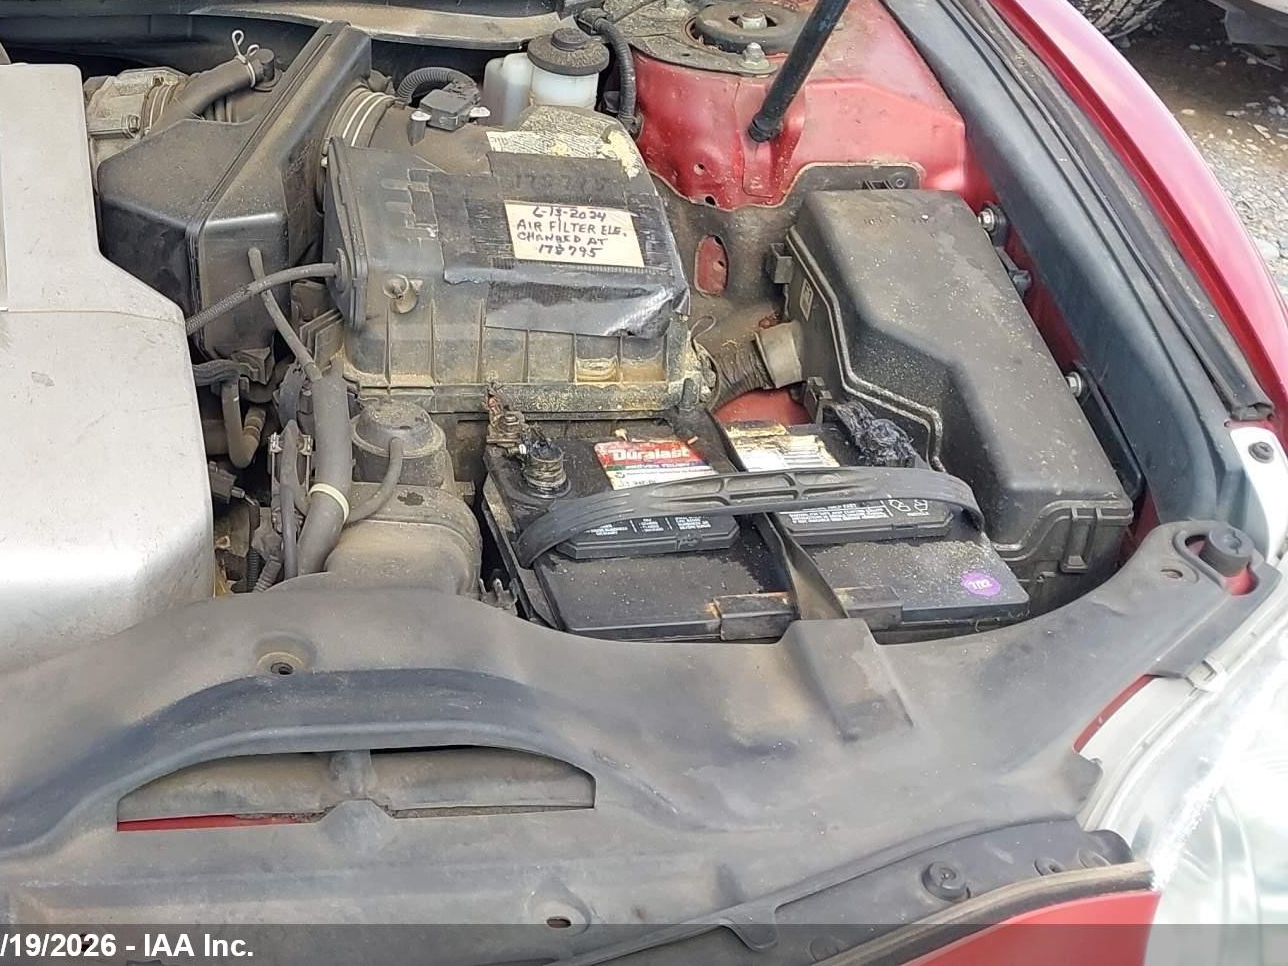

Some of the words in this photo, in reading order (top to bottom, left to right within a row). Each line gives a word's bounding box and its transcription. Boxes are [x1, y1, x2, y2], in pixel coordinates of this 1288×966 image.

[516, 219, 543, 232] AIR
[549, 217, 597, 234] FILTER
[586, 237, 609, 246] AT
[612, 446, 690, 461] Duralast
